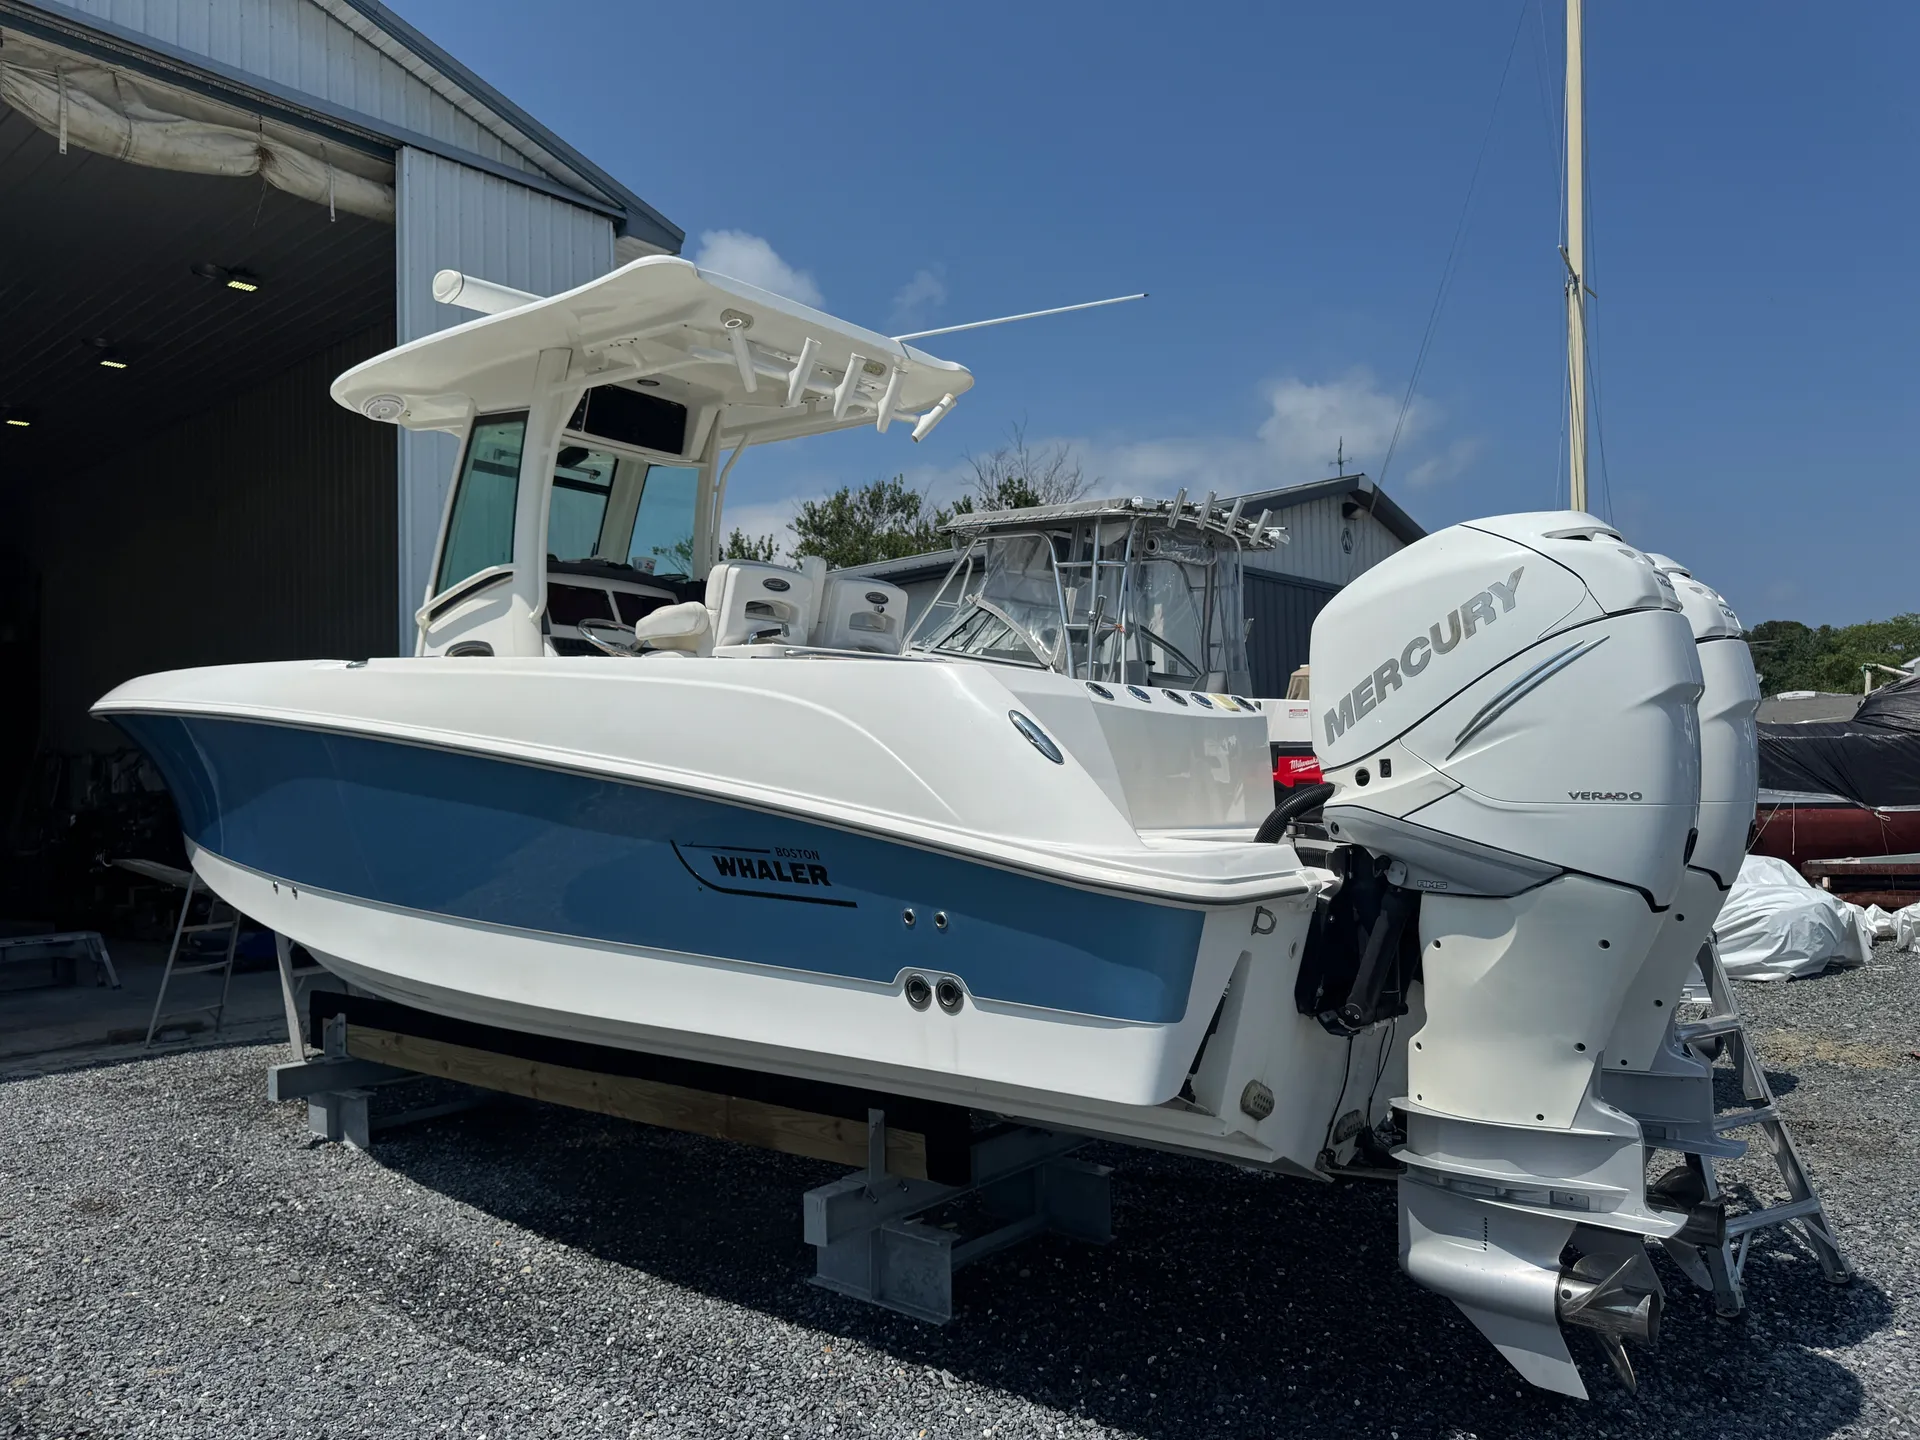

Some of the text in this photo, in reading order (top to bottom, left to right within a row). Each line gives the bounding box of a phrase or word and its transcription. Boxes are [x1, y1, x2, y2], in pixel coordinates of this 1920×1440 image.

[1323, 566, 1525, 747] MERCURY
[1289, 757, 1319, 770] Milwauk
[1567, 790, 1643, 801] VERADO
[775, 846, 820, 861] BOSTON
[711, 855, 832, 887] WHALER
